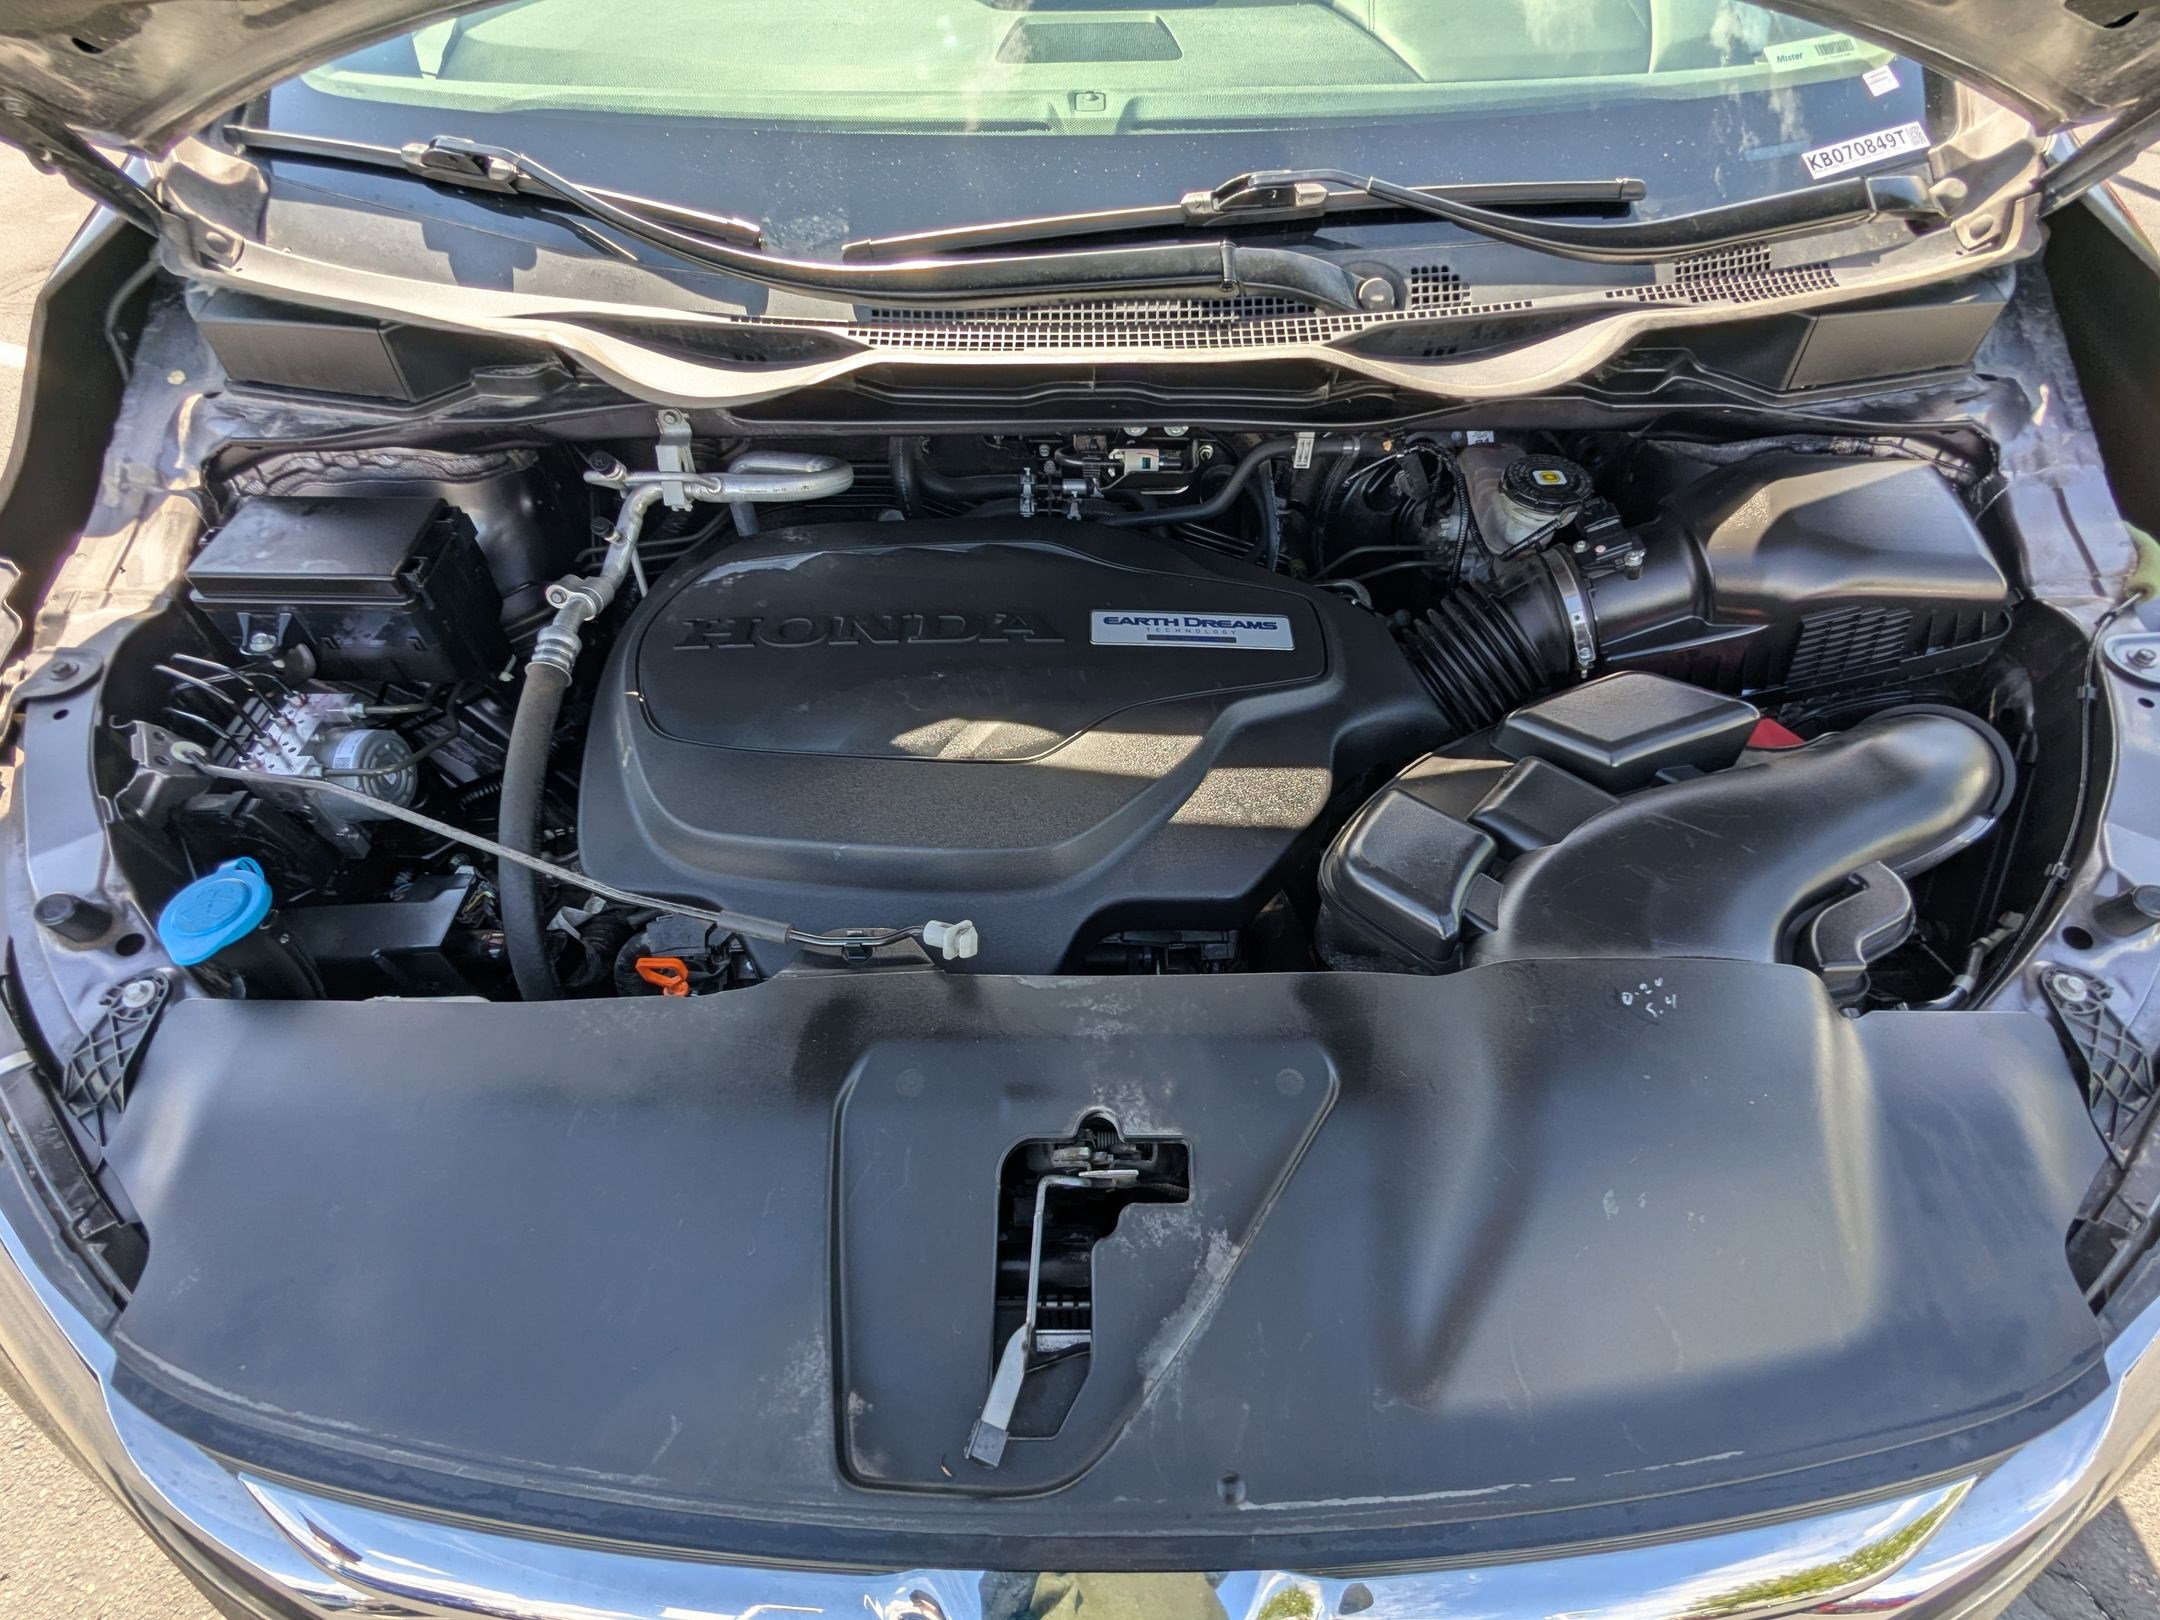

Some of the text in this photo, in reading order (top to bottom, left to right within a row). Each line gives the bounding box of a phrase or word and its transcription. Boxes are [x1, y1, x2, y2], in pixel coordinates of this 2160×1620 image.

[1807, 129, 1907, 171] KB070849T
[672, 613, 1065, 651] HONDA
[1103, 616, 1278, 630] EARTH DREAMS
[1146, 627, 1237, 635] TECHNOLOGY
